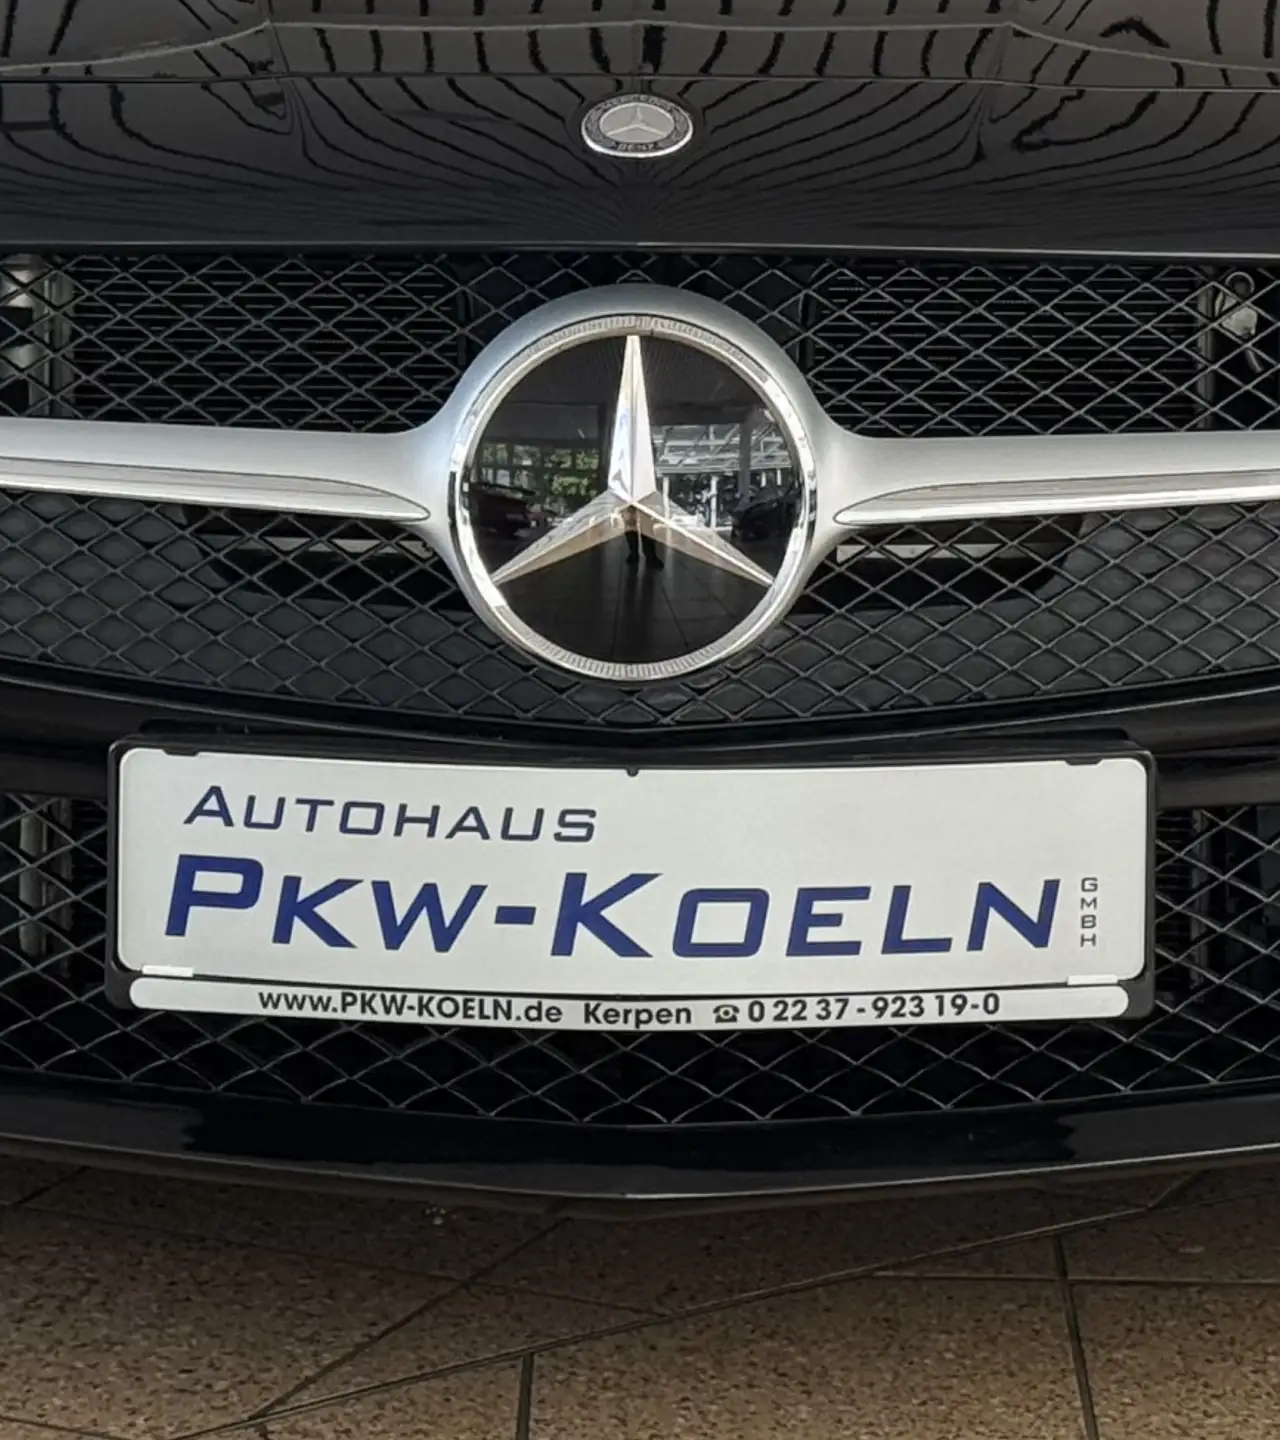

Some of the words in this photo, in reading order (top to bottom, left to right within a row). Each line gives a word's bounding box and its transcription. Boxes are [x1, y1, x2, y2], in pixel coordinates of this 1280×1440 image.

[183, 785, 597, 843] AUTOHAUS
[165, 854, 1060, 959] PKW-KOELN
[1079, 876, 1099, 948] GMBH
[259, 991, 563, 1024] www.PKW-KOELN.de
[583, 1002, 692, 1032] Kerpen
[748, 1000, 765, 1023] 0
[772, 999, 807, 1022] 22
[815, 997, 850, 1021] 37
[871, 994, 925, 1019] 923
[935, 992, 1000, 1017] 19-0
